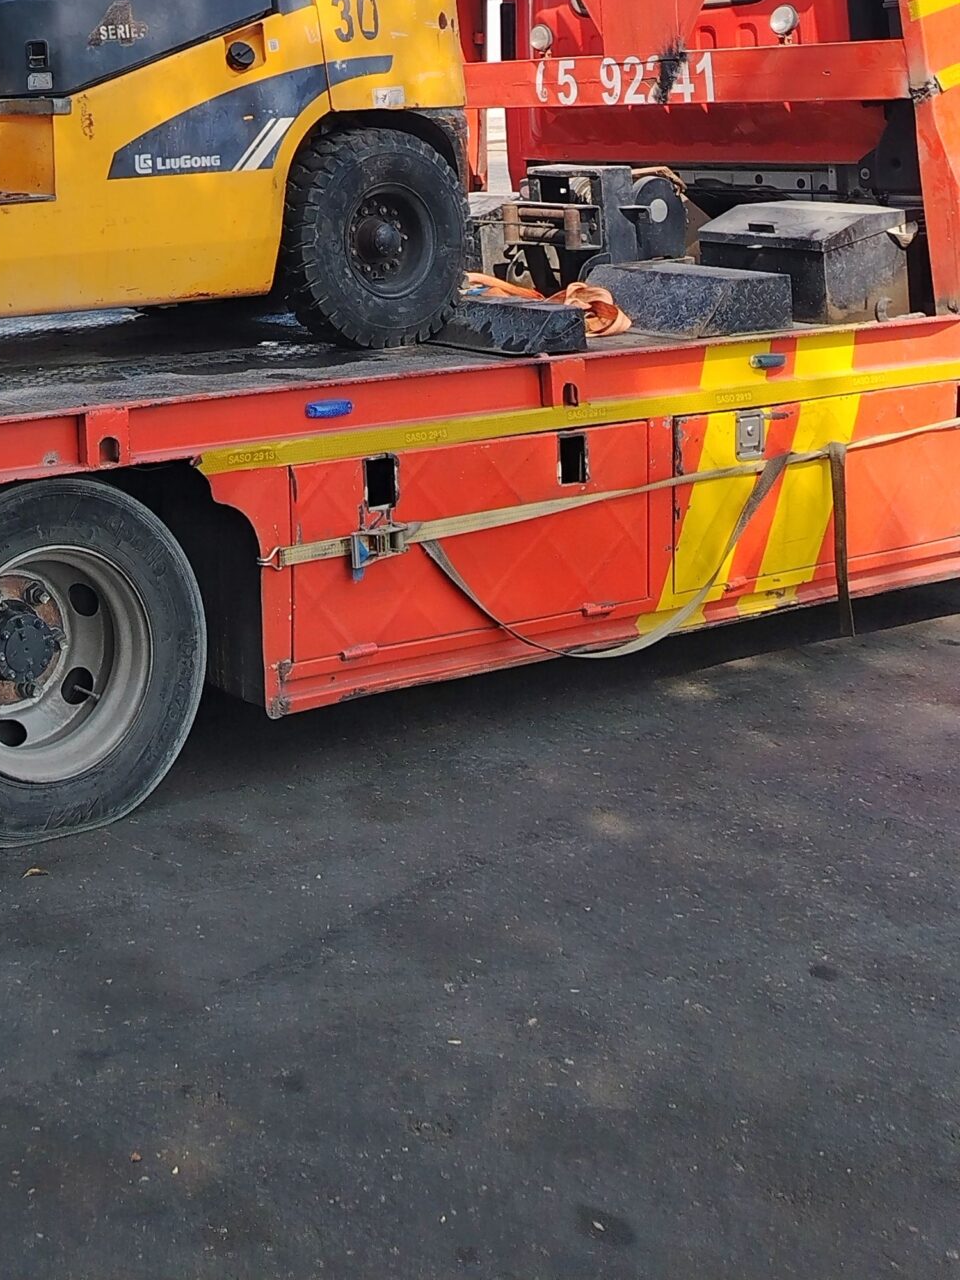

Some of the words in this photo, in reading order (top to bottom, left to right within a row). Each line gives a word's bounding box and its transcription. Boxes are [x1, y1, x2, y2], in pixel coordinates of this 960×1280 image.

[716, 393, 735, 404] SASO
[405, 431, 427, 443] SASO
[228, 453, 252, 465] SASO
[253, 450, 275, 461] 2913
